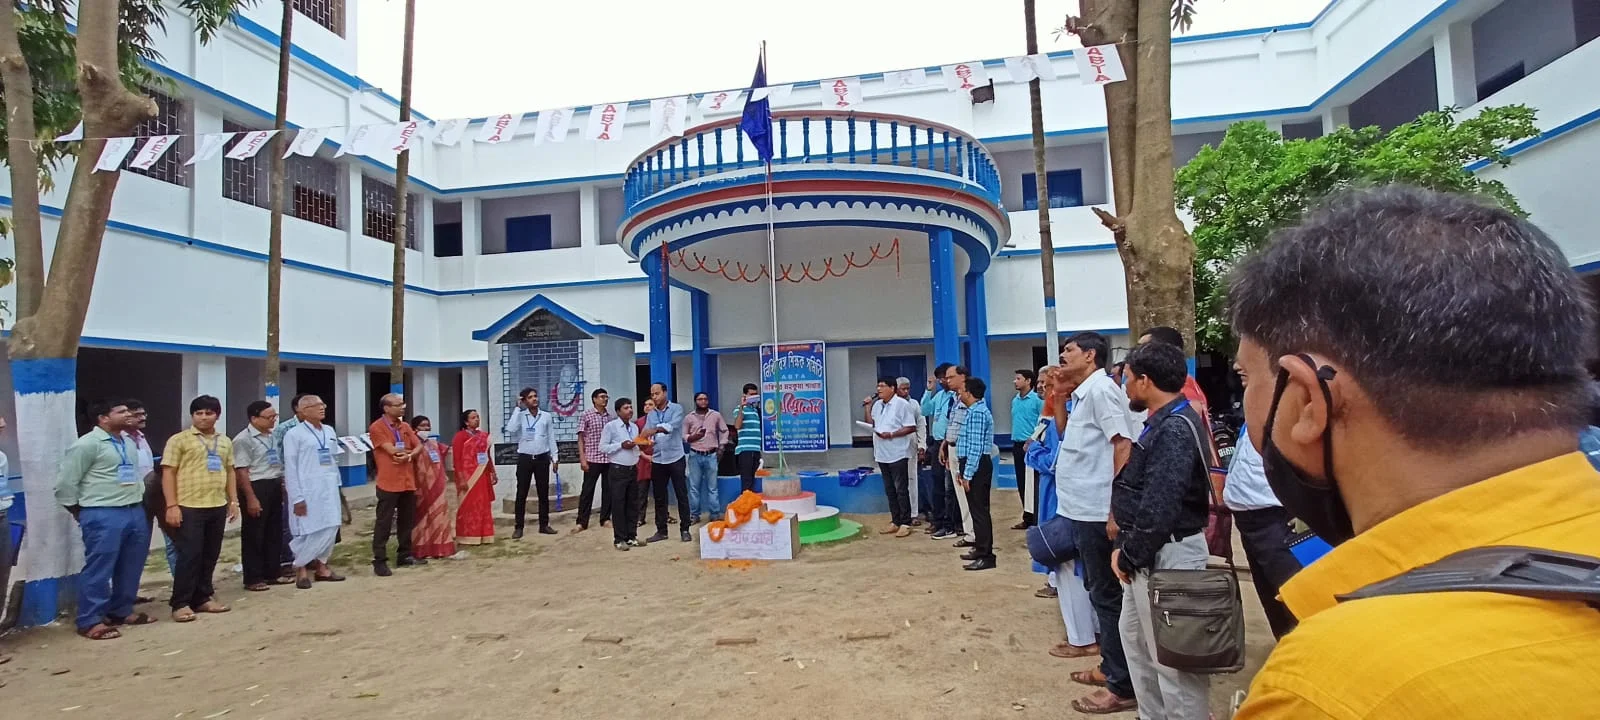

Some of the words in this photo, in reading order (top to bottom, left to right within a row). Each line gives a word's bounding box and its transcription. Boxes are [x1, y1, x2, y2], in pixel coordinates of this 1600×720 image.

[955, 64, 975, 89] ABTA
[1087, 47, 1111, 82] ABTA
[597, 104, 616, 140] ABTA
